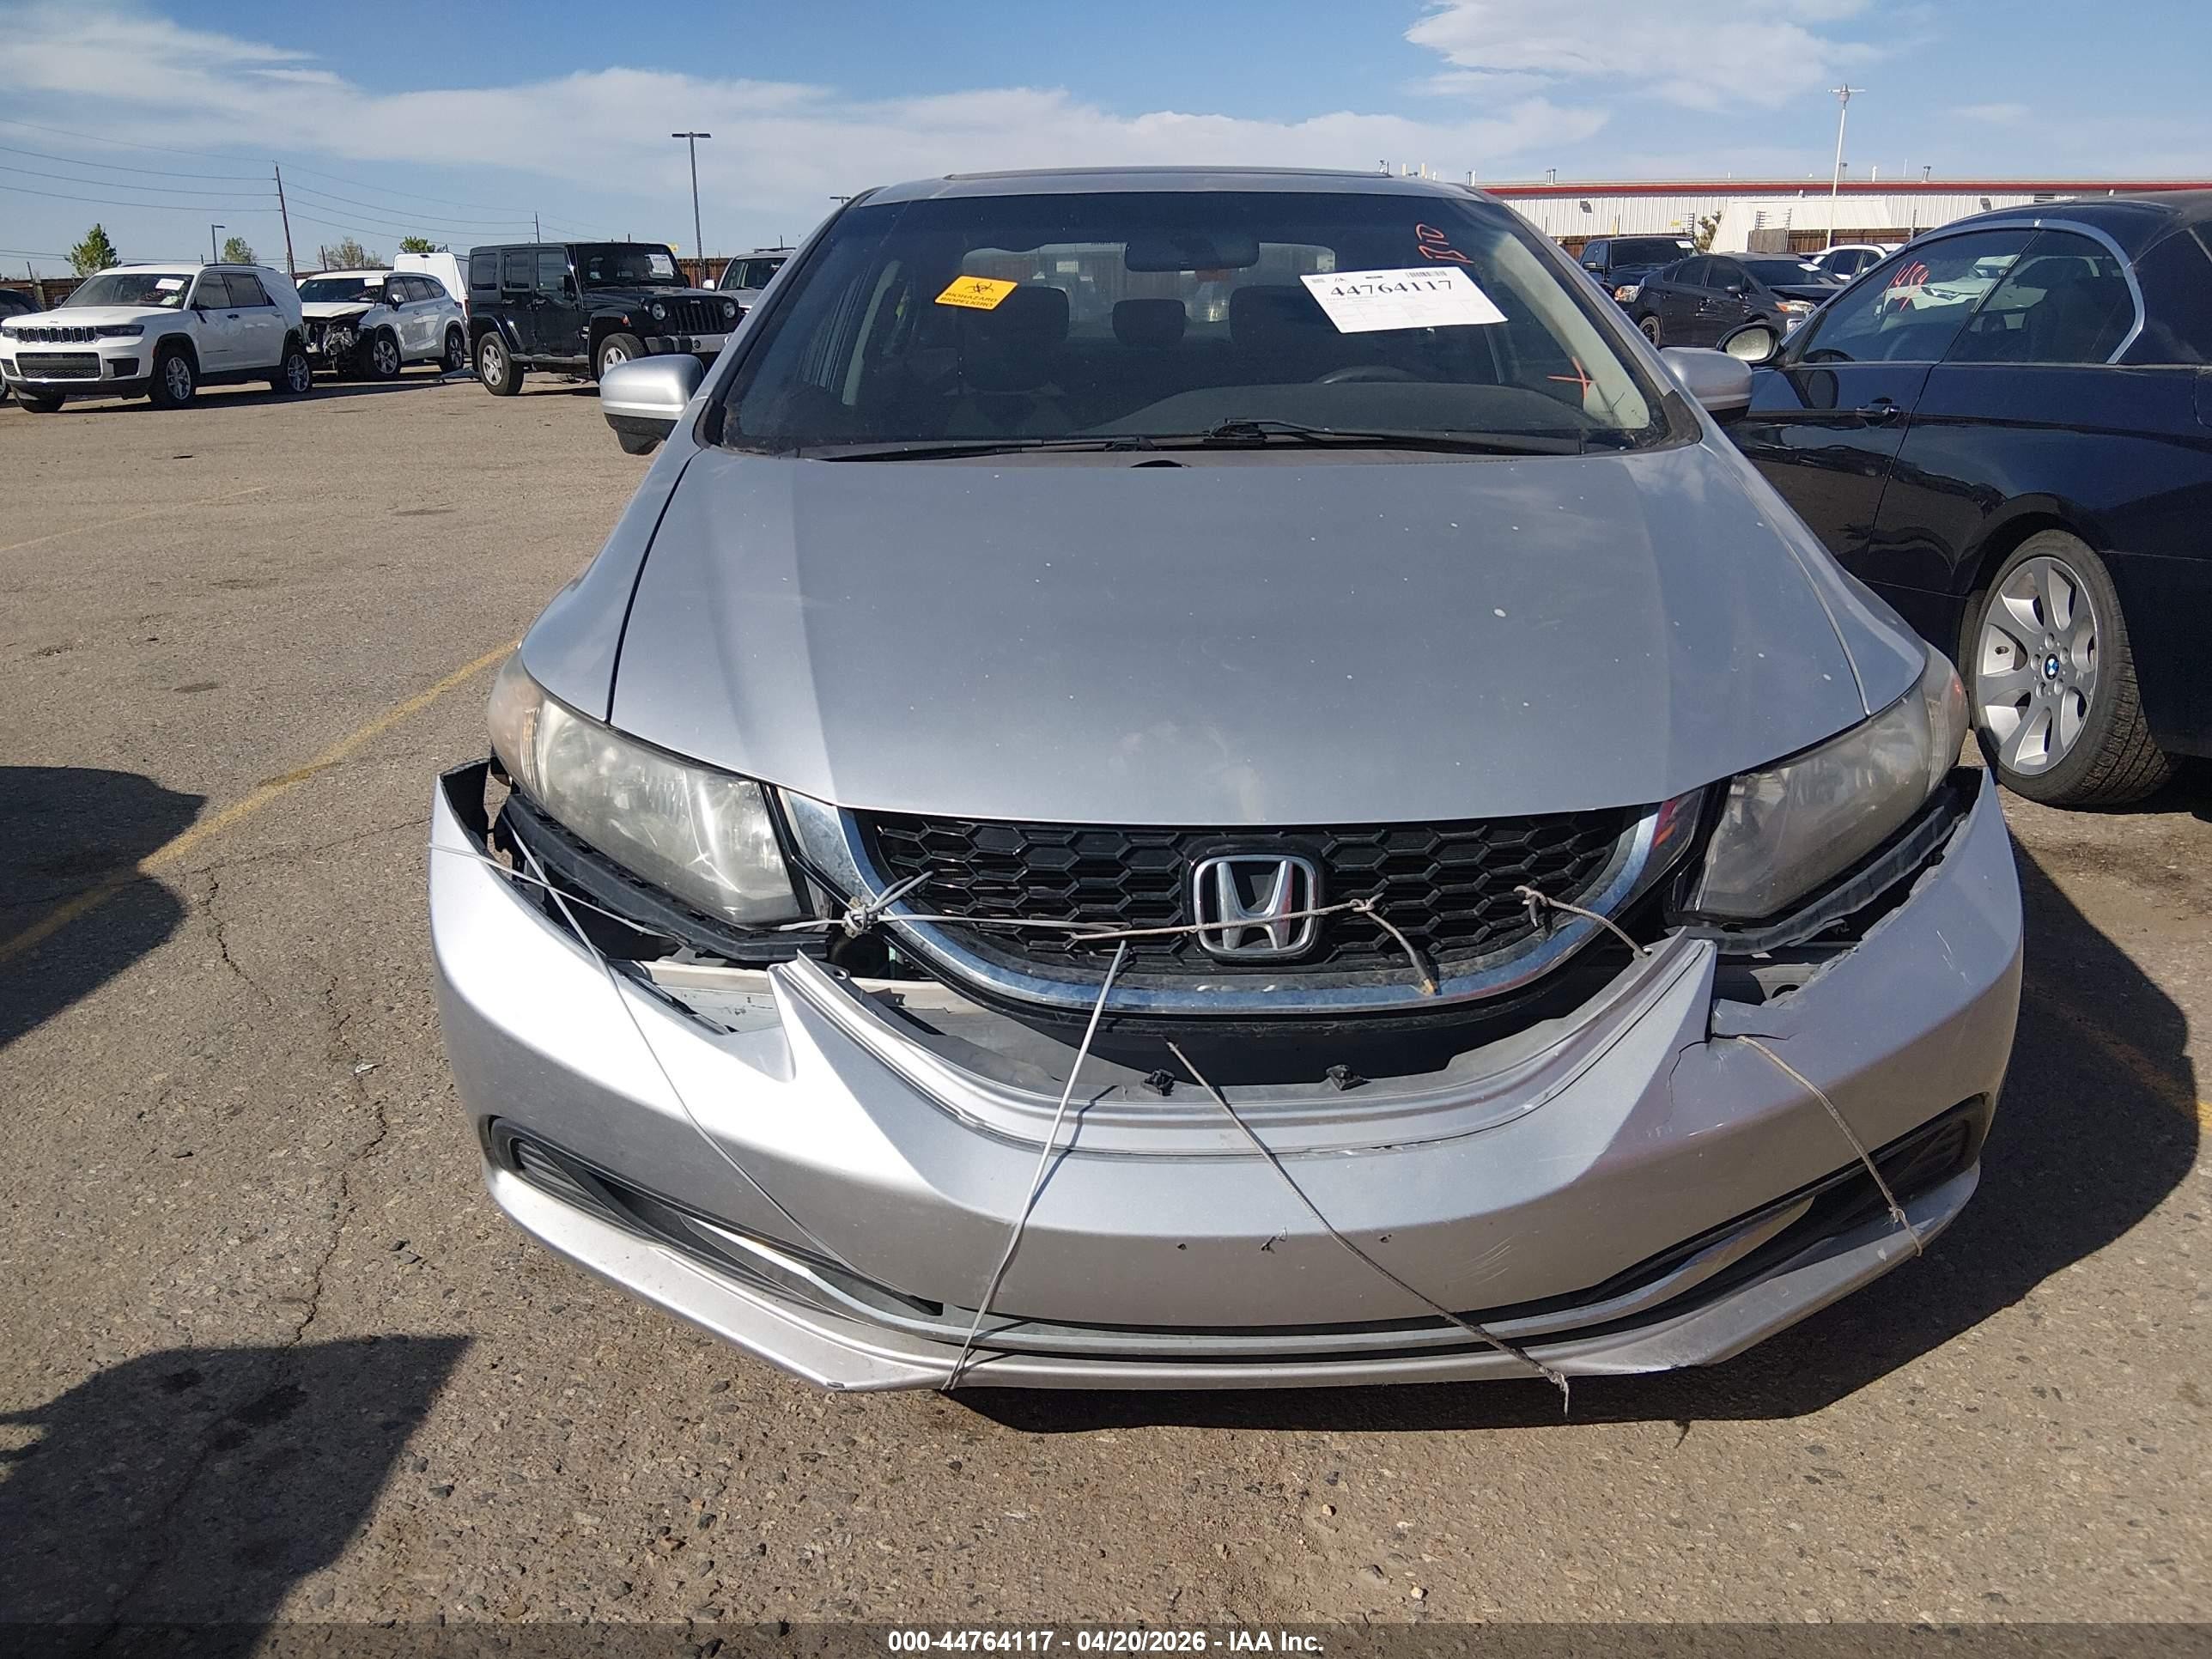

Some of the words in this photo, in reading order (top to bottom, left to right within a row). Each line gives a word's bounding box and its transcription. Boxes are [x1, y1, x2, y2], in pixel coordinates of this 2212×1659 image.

[1331, 280, 1452, 296] 44764117
[939, 296, 994, 307] BIOPELIGRO
[945, 292, 998, 303] BIOHAZARD
